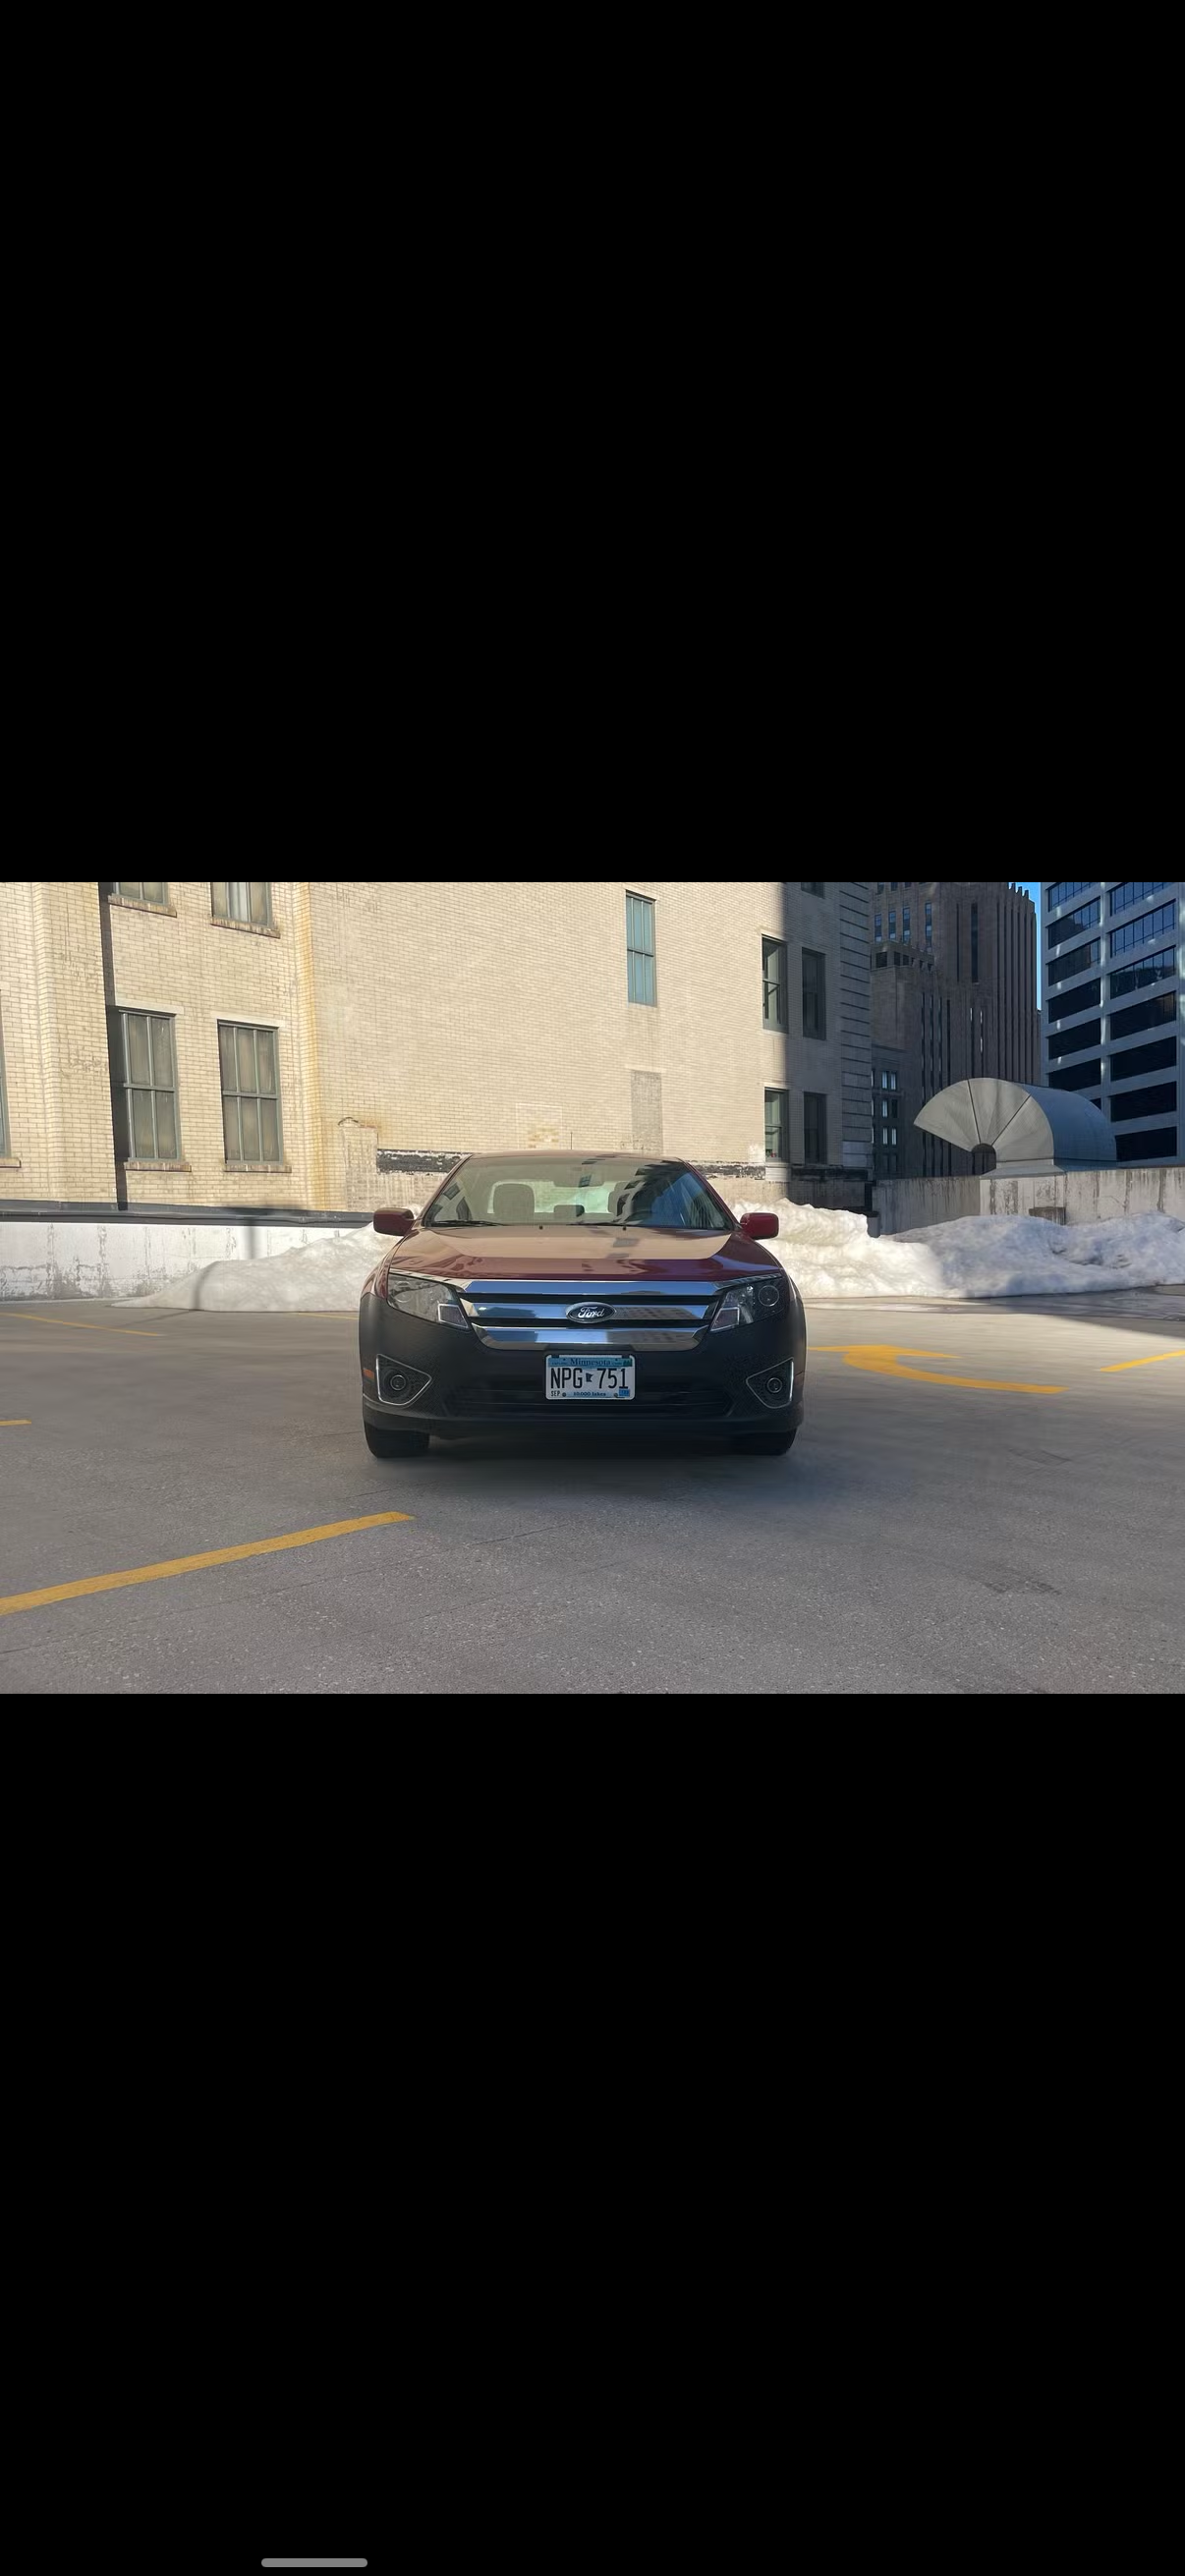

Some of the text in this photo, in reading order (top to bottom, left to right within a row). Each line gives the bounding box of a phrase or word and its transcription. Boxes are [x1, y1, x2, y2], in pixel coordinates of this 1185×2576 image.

[578, 1306, 605, 1318] Ford
[570, 1358, 611, 1367] Minnesota
[550, 1368, 629, 1389] NPG 751
